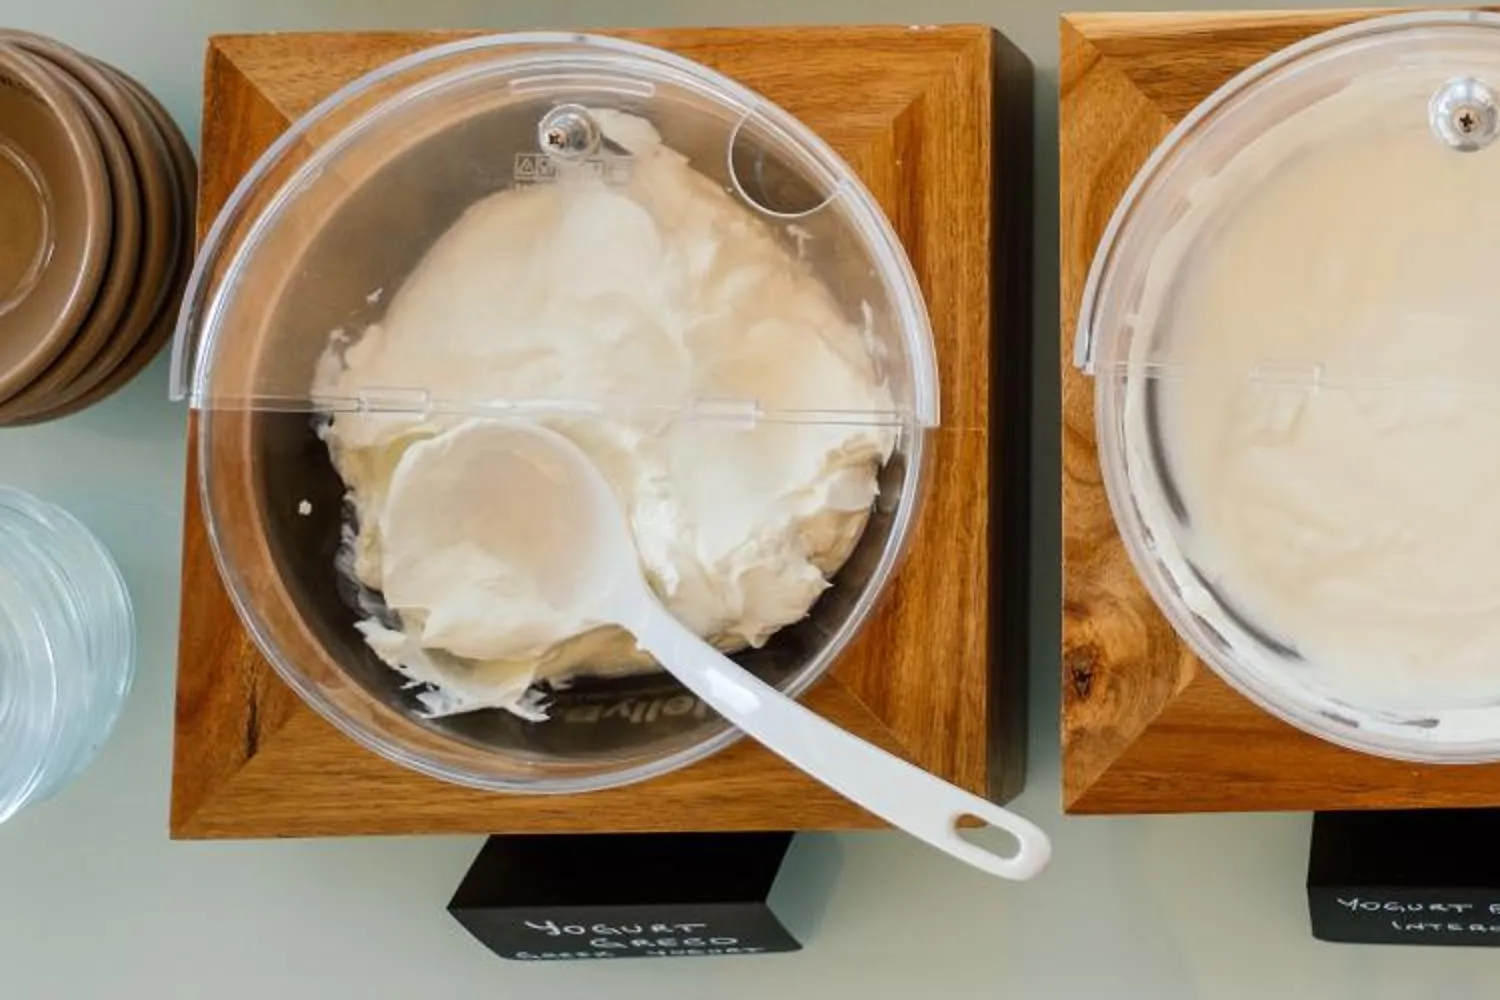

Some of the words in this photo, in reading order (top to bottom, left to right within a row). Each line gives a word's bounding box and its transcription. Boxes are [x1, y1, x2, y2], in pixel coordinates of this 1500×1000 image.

[1337, 898, 1473, 912] YOGURT
[525, 920, 706, 935] YOGURT
[590, 938, 738, 948] GRECO
